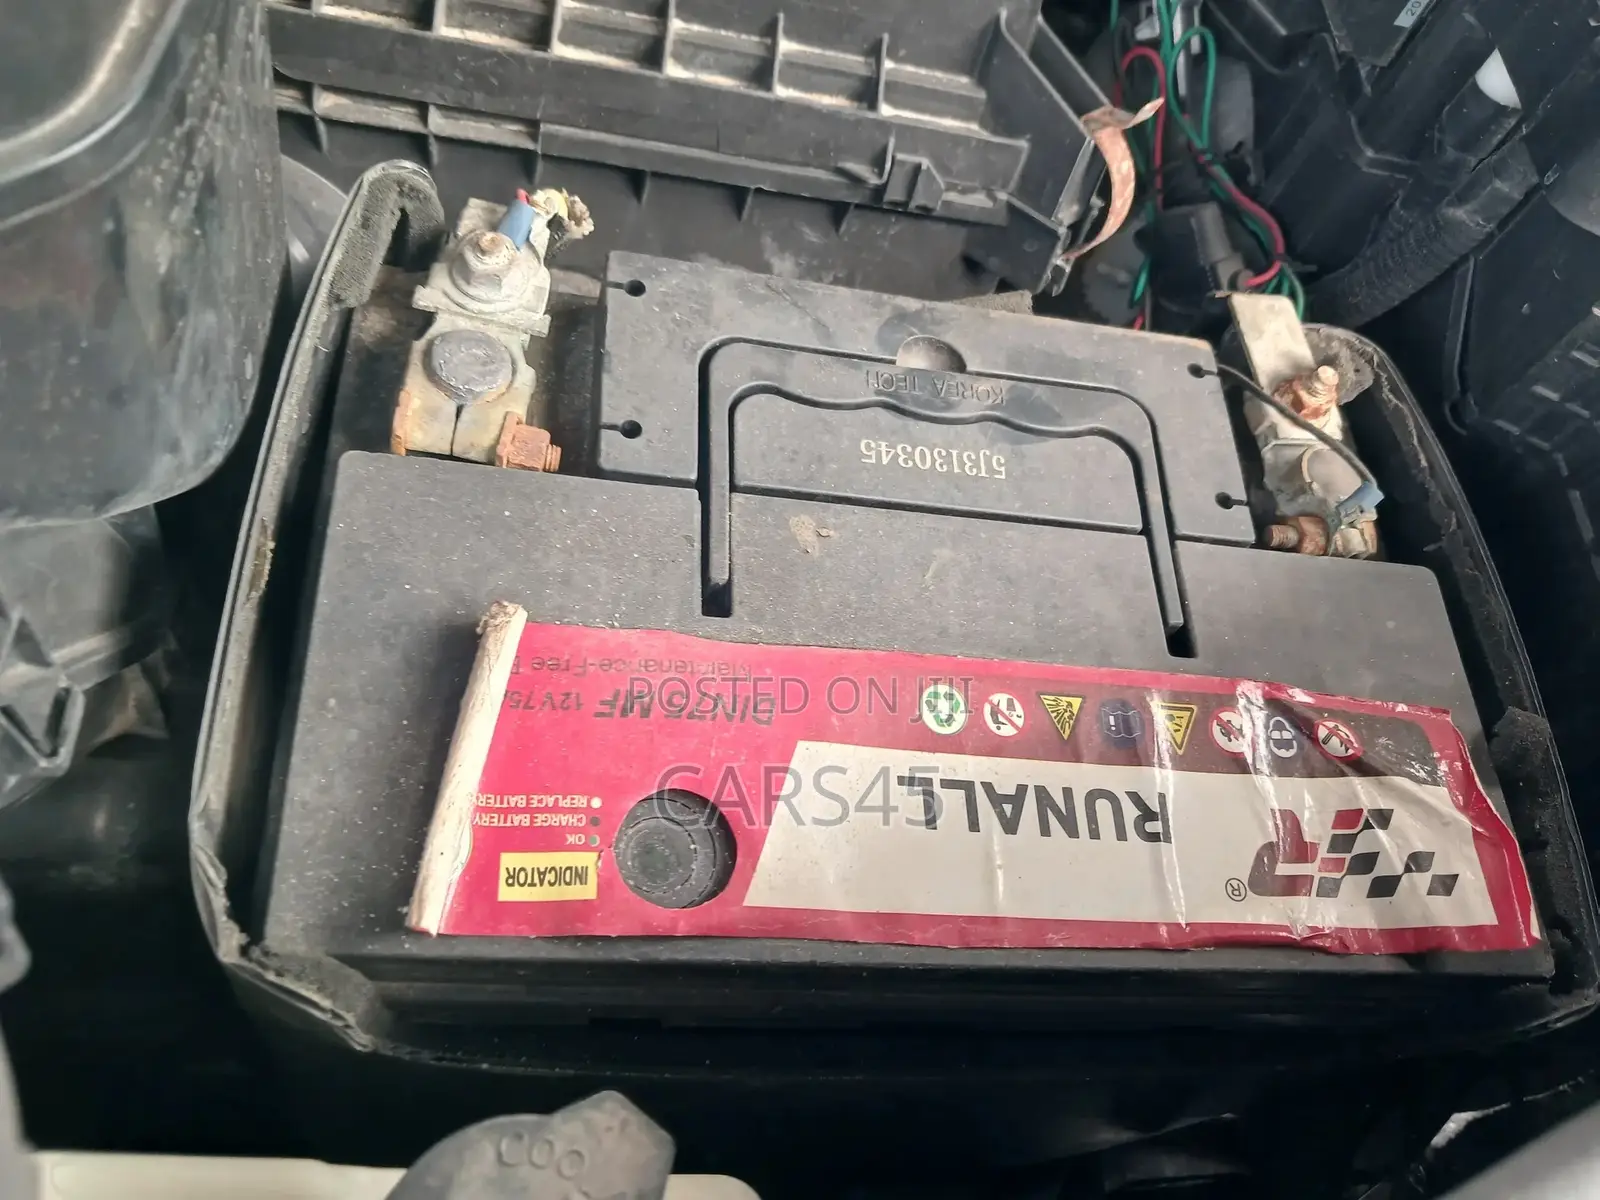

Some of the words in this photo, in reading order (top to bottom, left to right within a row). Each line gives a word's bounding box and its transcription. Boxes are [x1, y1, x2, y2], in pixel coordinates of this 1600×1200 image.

[932, 376, 1005, 406] KOREA
[860, 439, 1006, 479] 5J3130345
[529, 794, 588, 808] REPLACE
[897, 775, 1172, 843] RUNALL
[473, 812, 531, 827] BATTERY
[533, 813, 587, 827] CHARGE
[565, 833, 586, 846] OK
[505, 865, 589, 888] INDICATOR
